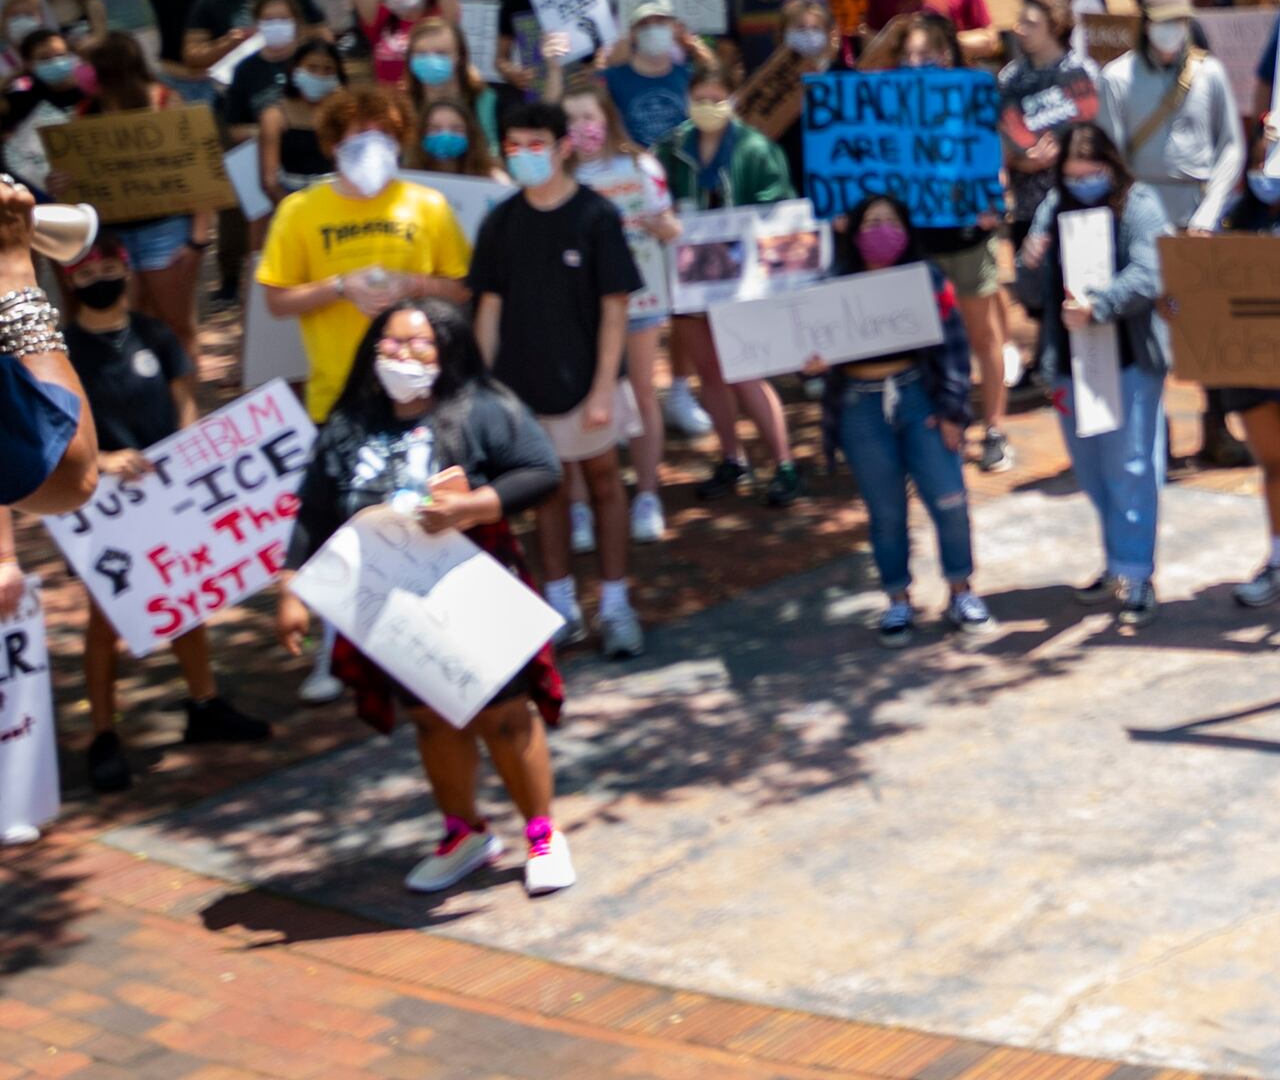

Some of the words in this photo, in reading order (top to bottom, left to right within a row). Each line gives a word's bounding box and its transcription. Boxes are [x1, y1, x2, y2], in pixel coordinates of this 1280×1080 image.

[829, 136, 900, 165] ARE
[913, 134, 980, 166] NOT
[176, 392, 286, 468] #BLM
[146, 543, 212, 586] Fix
[211, 491, 302, 544] The
[145, 540, 287, 638] SYSTE
